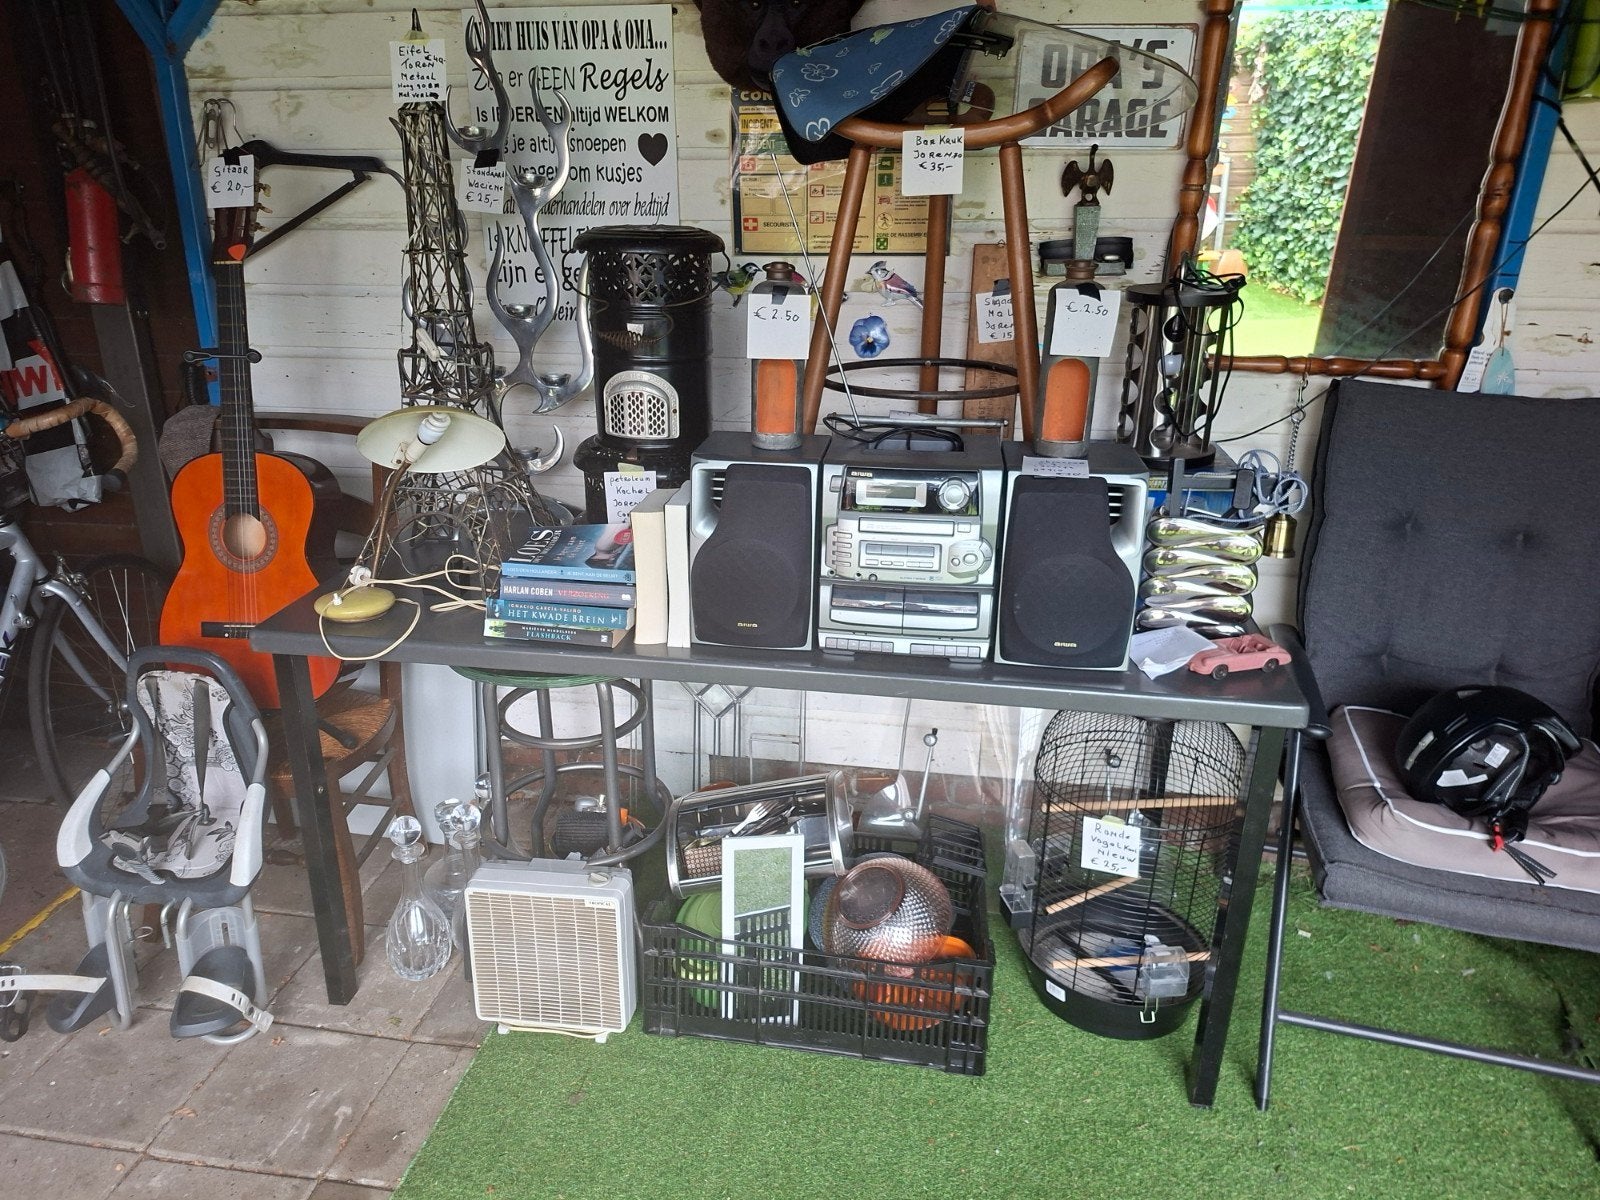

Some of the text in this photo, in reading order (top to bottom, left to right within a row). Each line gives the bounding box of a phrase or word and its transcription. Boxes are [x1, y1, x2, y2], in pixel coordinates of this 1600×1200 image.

[515, 21, 549, 51] HUIS
[551, 20, 579, 50] VAN
[581, 20, 610, 50] OPA
[612, 19, 622, 50] &
[624, 19, 668, 50] OMA...
[508, 70, 524, 87] er
[579, 57, 669, 101] Regels
[476, 106, 488, 123] Is
[604, 105, 669, 123] WELKOM
[741, 118, 774, 129] INCIDENT
[512, 134, 526, 154] je
[529, 135, 559, 154] altij
[569, 136, 627, 155] snoepen
[513, 163, 643, 184] vrage om kusjes
[541, 191, 606, 216] derhandelen
[609, 201, 632, 216] over
[633, 192, 671, 224] bedtijd
[497, 259, 527, 288] ijn
[772, 308, 800, 322] 2.50
[508, 529, 554, 563] LOES
[504, 585, 529, 595] HARLAN
[531, 587, 553, 597] COBEN
[508, 609, 605, 624] HET KWADE BREIN
[526, 631, 572, 641] FLASHBACK
